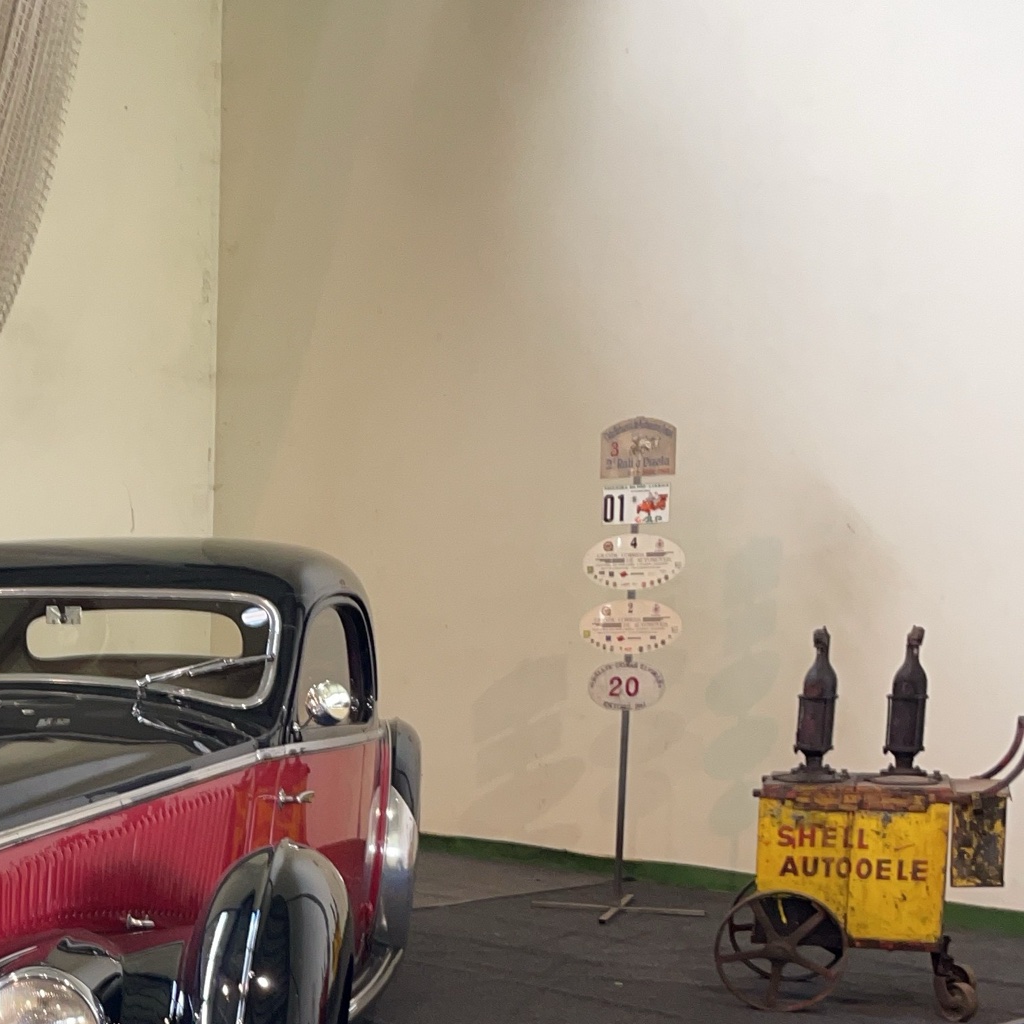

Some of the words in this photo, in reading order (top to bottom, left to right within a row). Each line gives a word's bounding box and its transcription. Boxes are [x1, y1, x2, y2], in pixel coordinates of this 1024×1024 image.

[610, 441, 619, 457] 3
[603, 494, 625, 523] 01
[630, 536, 638, 549] 4
[608, 675, 640, 697] 20
[777, 826, 869, 849] SHELL
[779, 855, 930, 881] AUTOOELE
